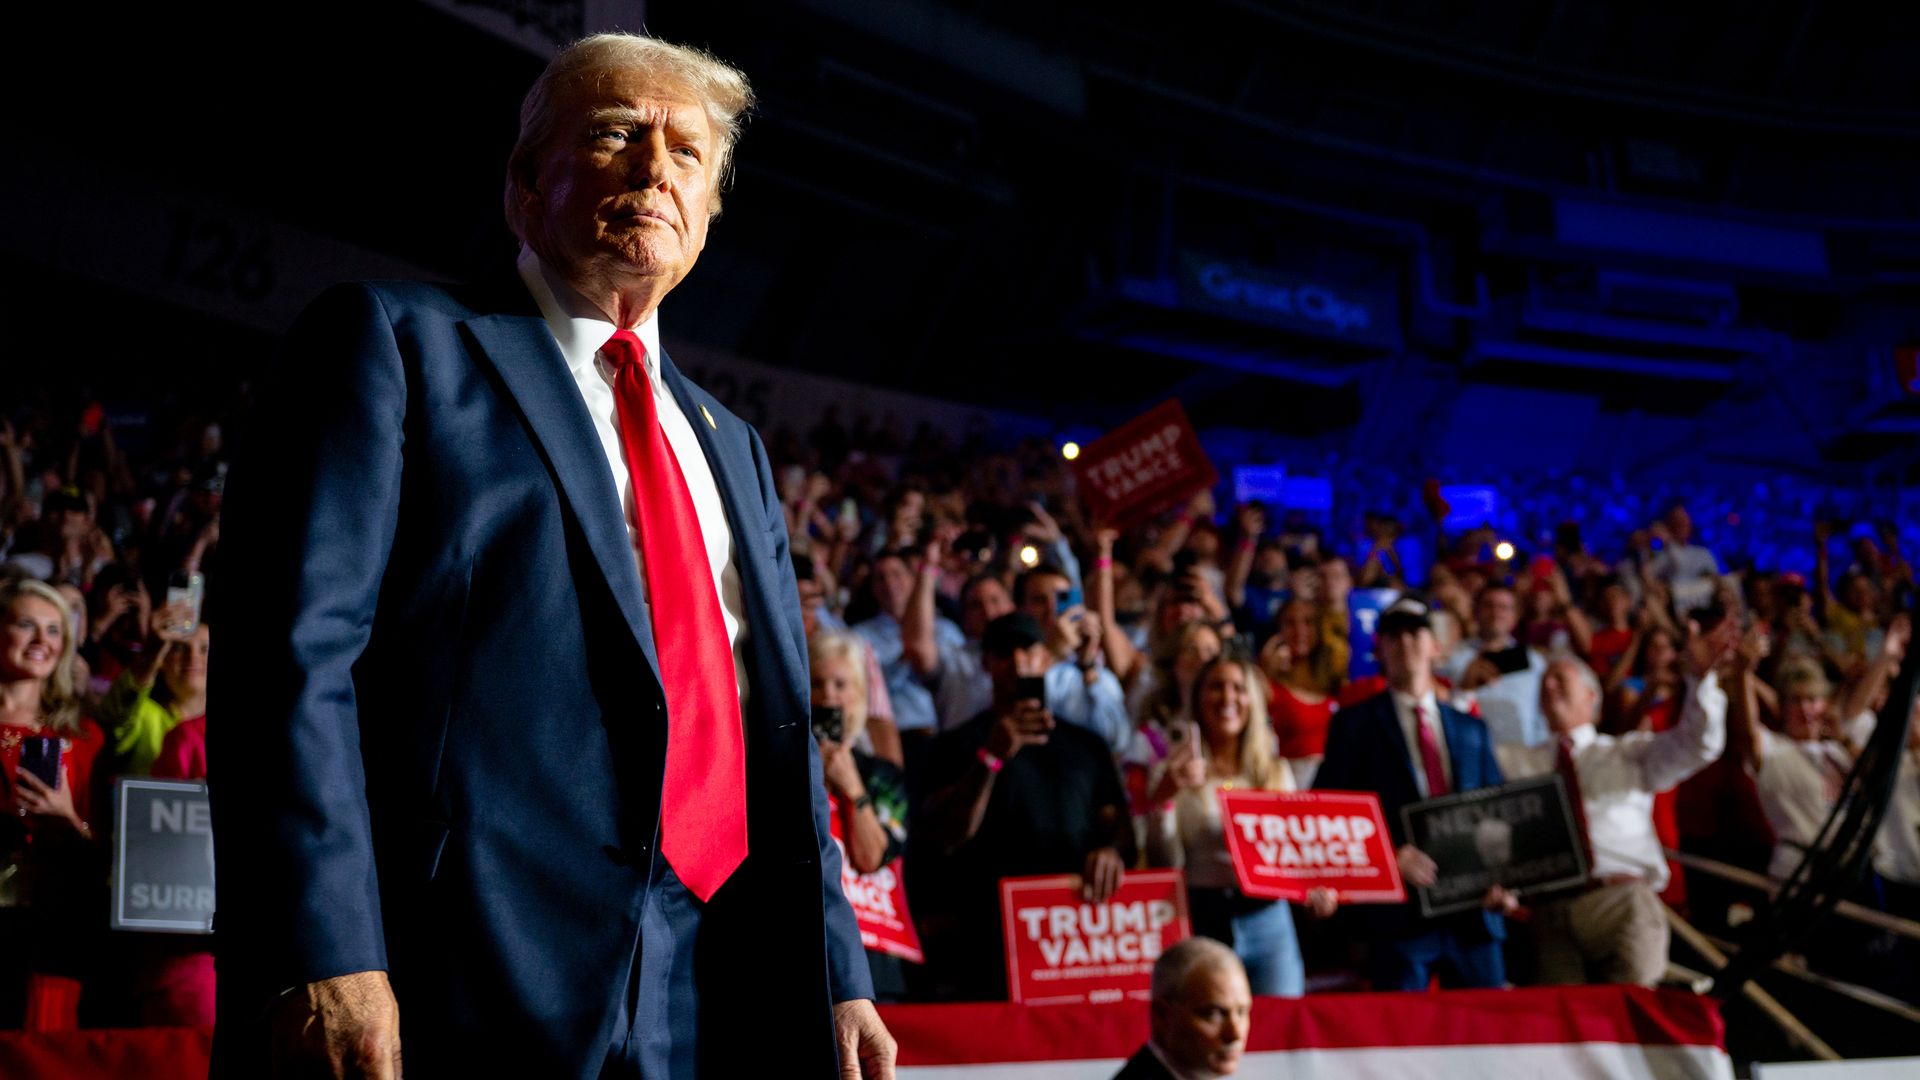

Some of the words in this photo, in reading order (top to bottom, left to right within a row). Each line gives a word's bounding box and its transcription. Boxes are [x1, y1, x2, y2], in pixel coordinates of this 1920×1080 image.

[1085, 423, 1183, 489] TRUMP
[1104, 449, 1183, 501] VANCE
[1233, 812, 1376, 844] TRUMP
[1254, 840, 1371, 867] VANCE
[1018, 900, 1175, 942] TRUMP
[1039, 931, 1162, 967] VANCE
